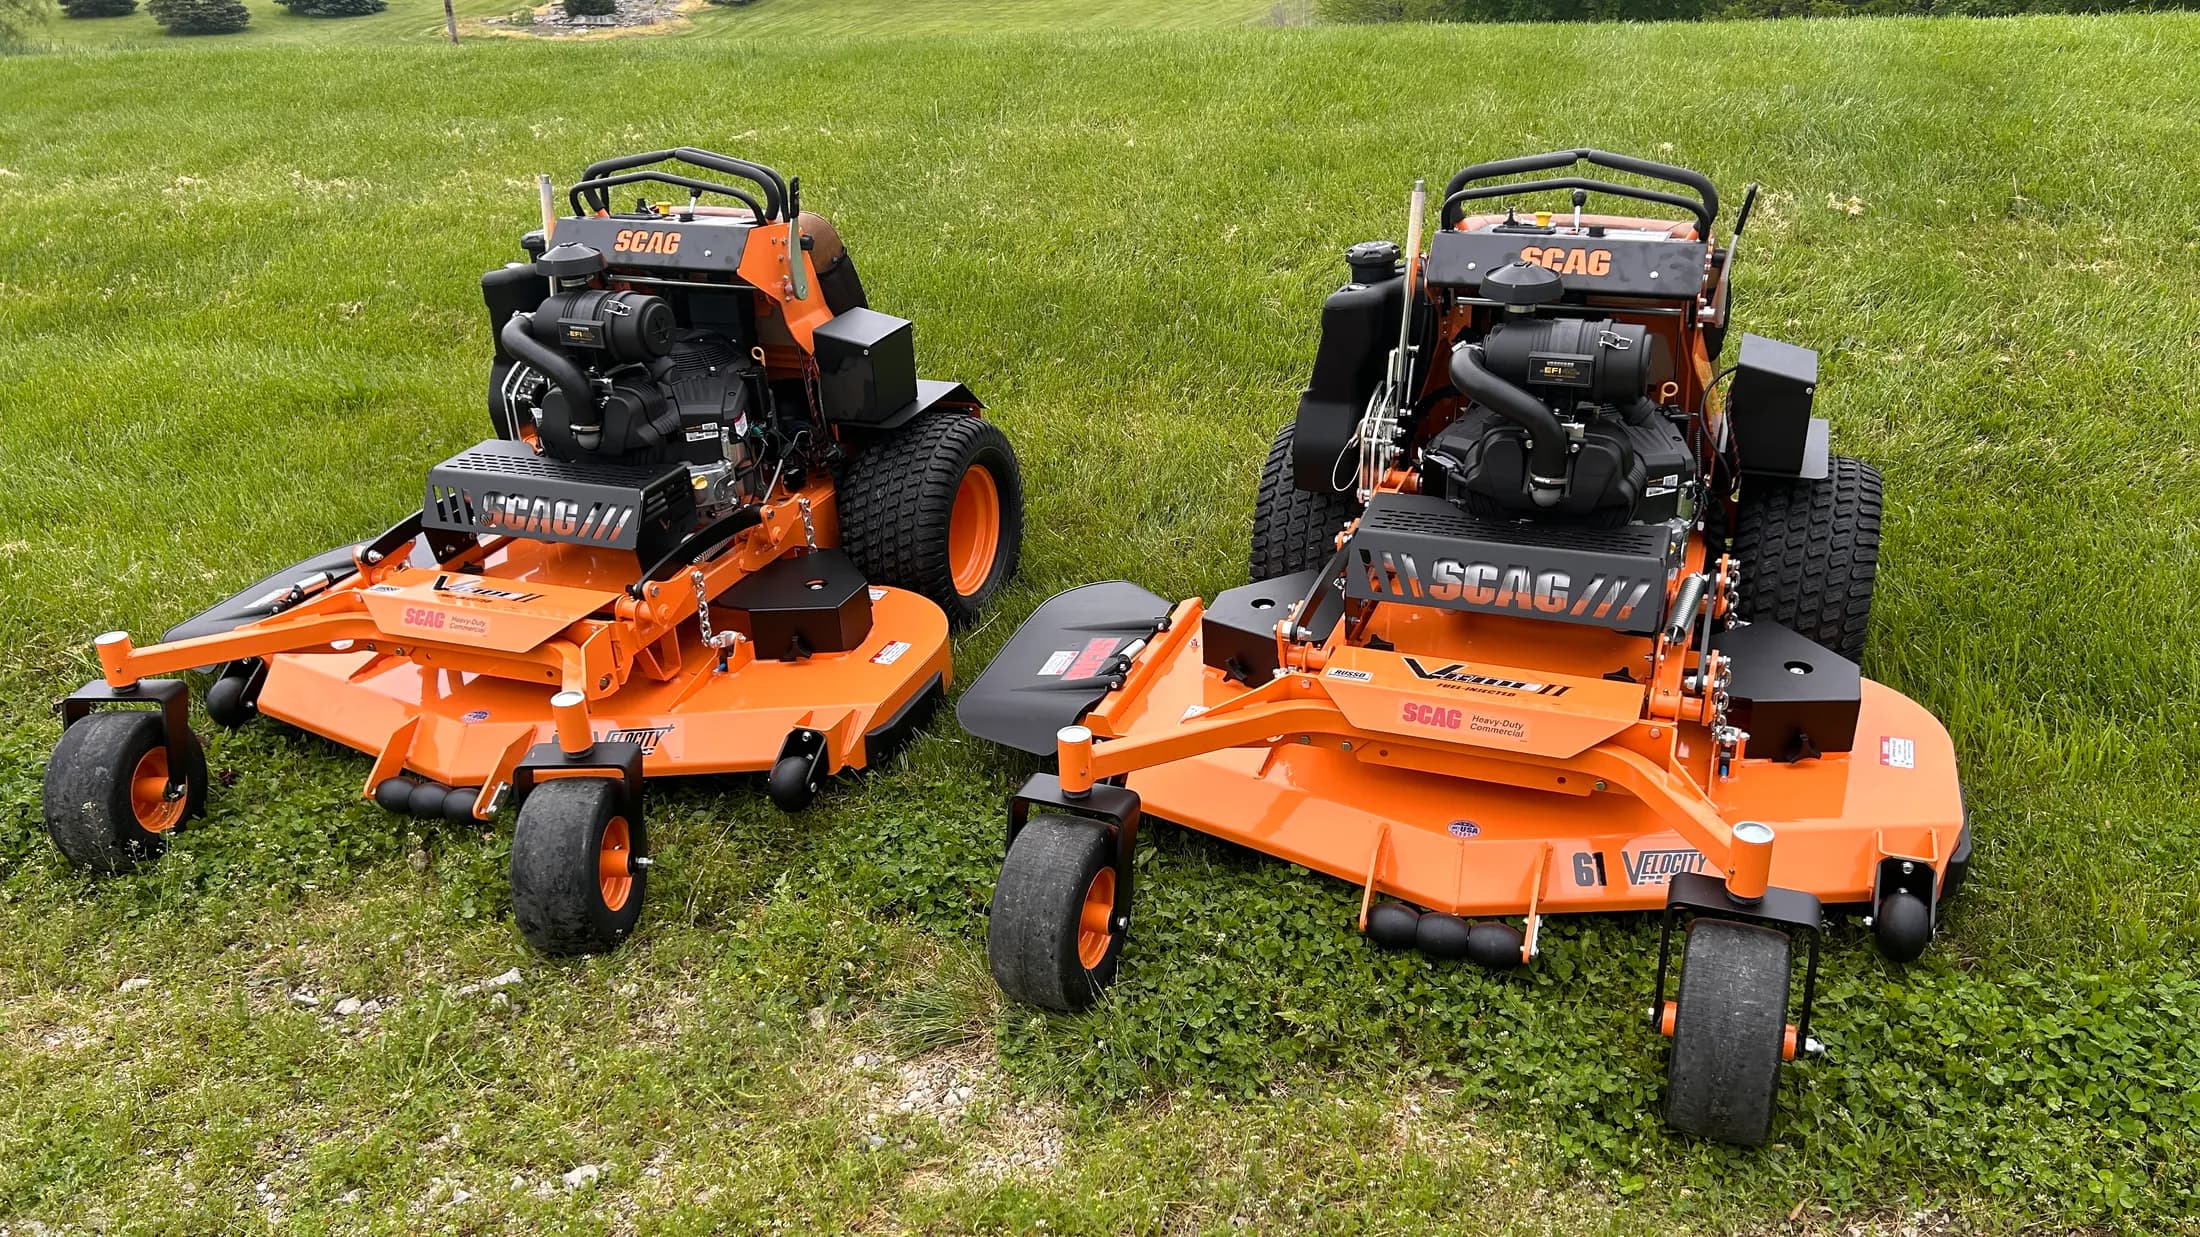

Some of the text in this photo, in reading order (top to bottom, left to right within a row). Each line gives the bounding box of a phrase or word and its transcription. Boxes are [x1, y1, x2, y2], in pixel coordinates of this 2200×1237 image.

[614, 229, 682, 255] SCAG
[1520, 246, 1612, 276] SCAG
[1544, 366, 1562, 375] EFI
[479, 490, 579, 537] SCAG
[1429, 557, 1571, 614] SCAG
[404, 607, 446, 629] SCAG
[451, 615, 487, 628] Heavy-Duty
[1436, 683, 1517, 698] FUEL-INJECTED
[1402, 702, 1463, 730] SCAG
[1471, 715, 1525, 731] Heavy-Duty
[1469, 723, 1525, 738] Commercial
[1460, 826, 1478, 835] USA
[1572, 851, 1608, 886] 61
[1621, 850, 1708, 886] VELOCITY
